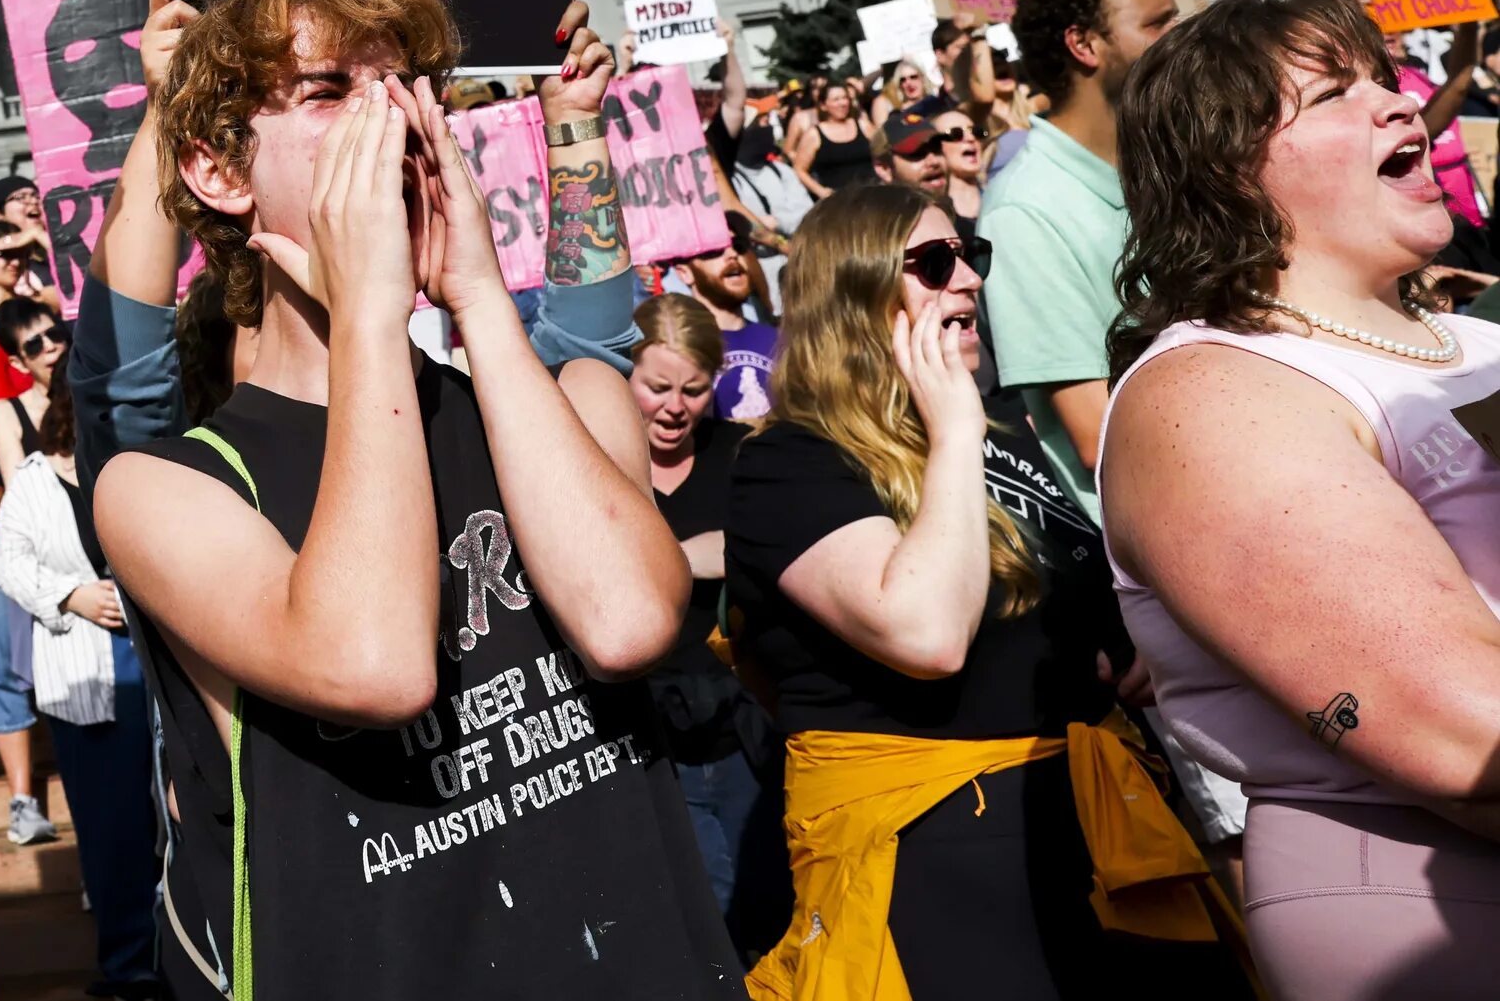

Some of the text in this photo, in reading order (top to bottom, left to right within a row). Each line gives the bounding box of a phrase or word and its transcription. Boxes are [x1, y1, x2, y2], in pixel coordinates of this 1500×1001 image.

[615, 146, 720, 210] OICE
[450, 666, 526, 736] KEEP
[430, 694, 595, 799] OFF DRUGS
[414, 793, 507, 859] AUSTIN
[510, 758, 583, 817] POLICE
